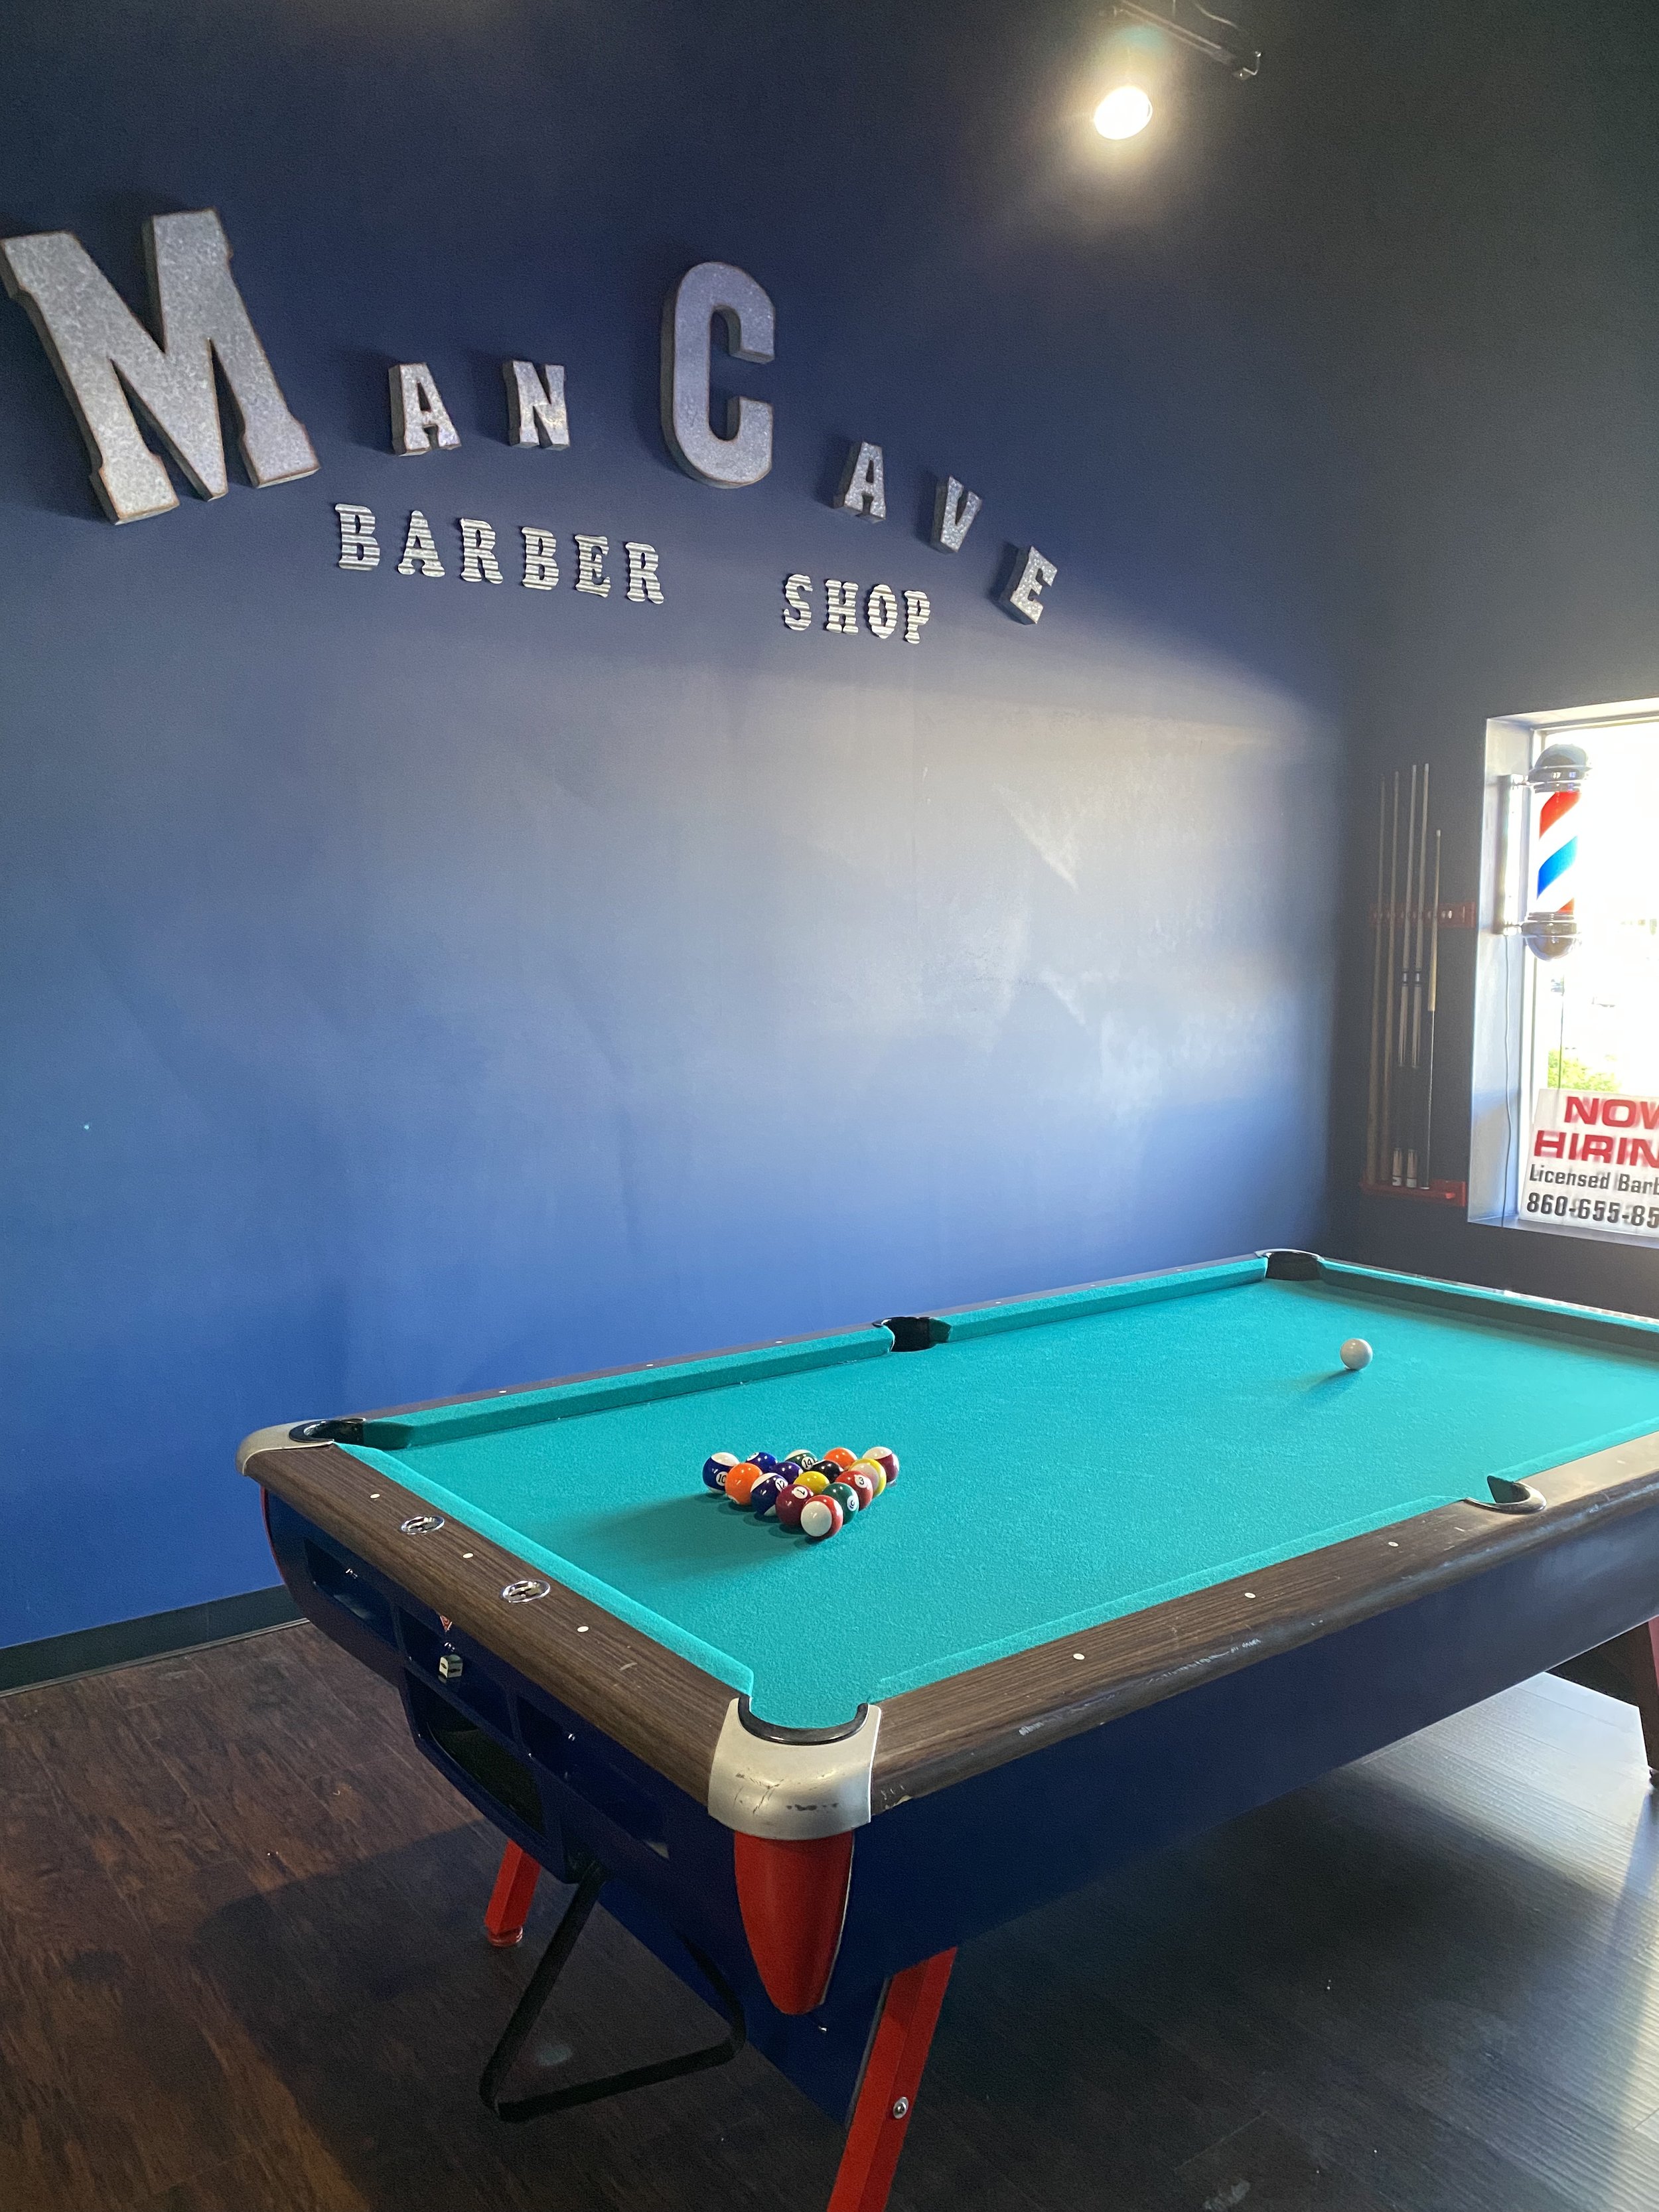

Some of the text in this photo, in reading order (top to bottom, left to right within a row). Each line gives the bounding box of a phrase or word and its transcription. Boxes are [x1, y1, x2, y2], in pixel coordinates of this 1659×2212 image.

[0, 208, 1058, 625] MAN CAVE
[334, 503, 930, 644] BARBER SHOP
[1529, 1164, 1611, 1190] Licensed
[1527, 1193, 1659, 1228] 860-655-85
[804, 1459, 813, 1468] 14
[859, 1477, 865, 1485] 3
